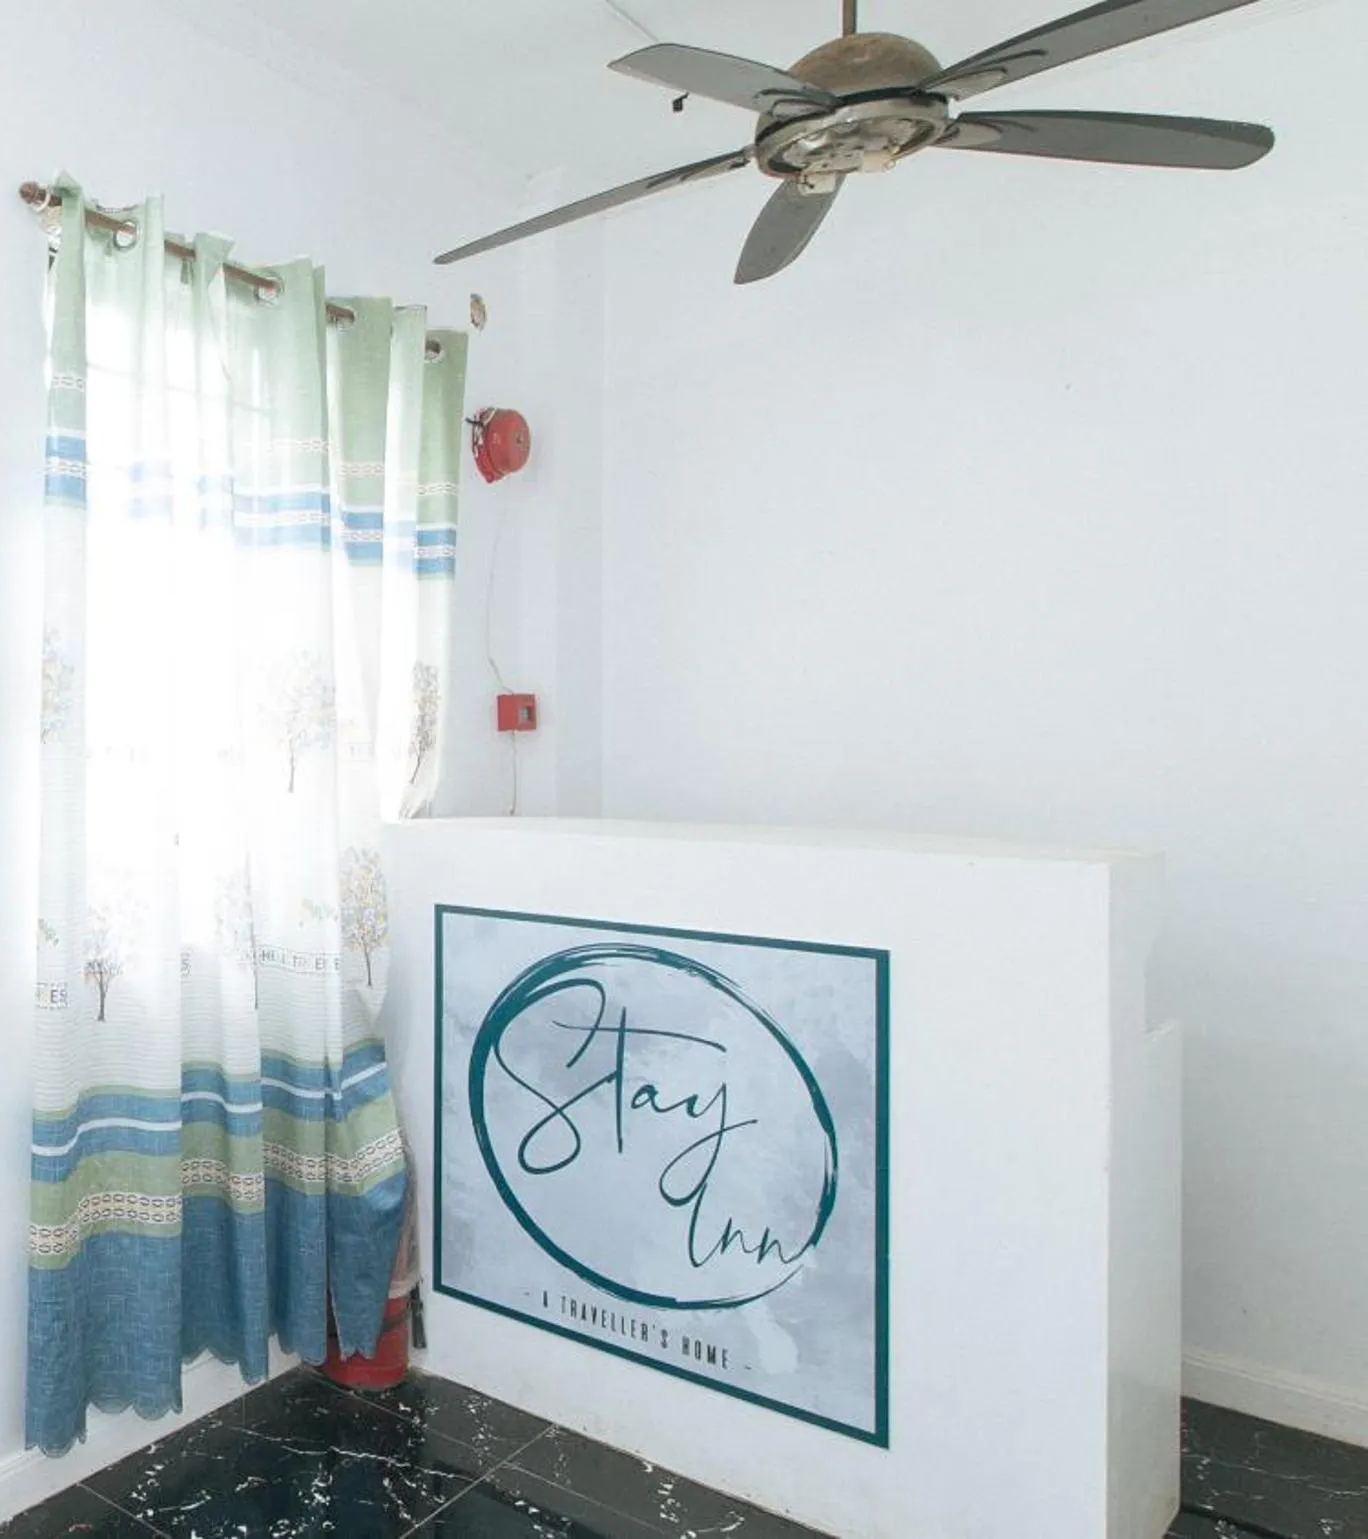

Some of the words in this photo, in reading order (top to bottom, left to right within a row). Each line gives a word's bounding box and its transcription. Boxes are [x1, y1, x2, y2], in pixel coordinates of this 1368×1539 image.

[492, 977, 758, 1207] Stay
[688, 1183, 815, 1268] Inn
[542, 1290, 549, 1309] A
[560, 1295, 669, 1350] TRAVELLER'S
[682, 1335, 729, 1370] HOME
